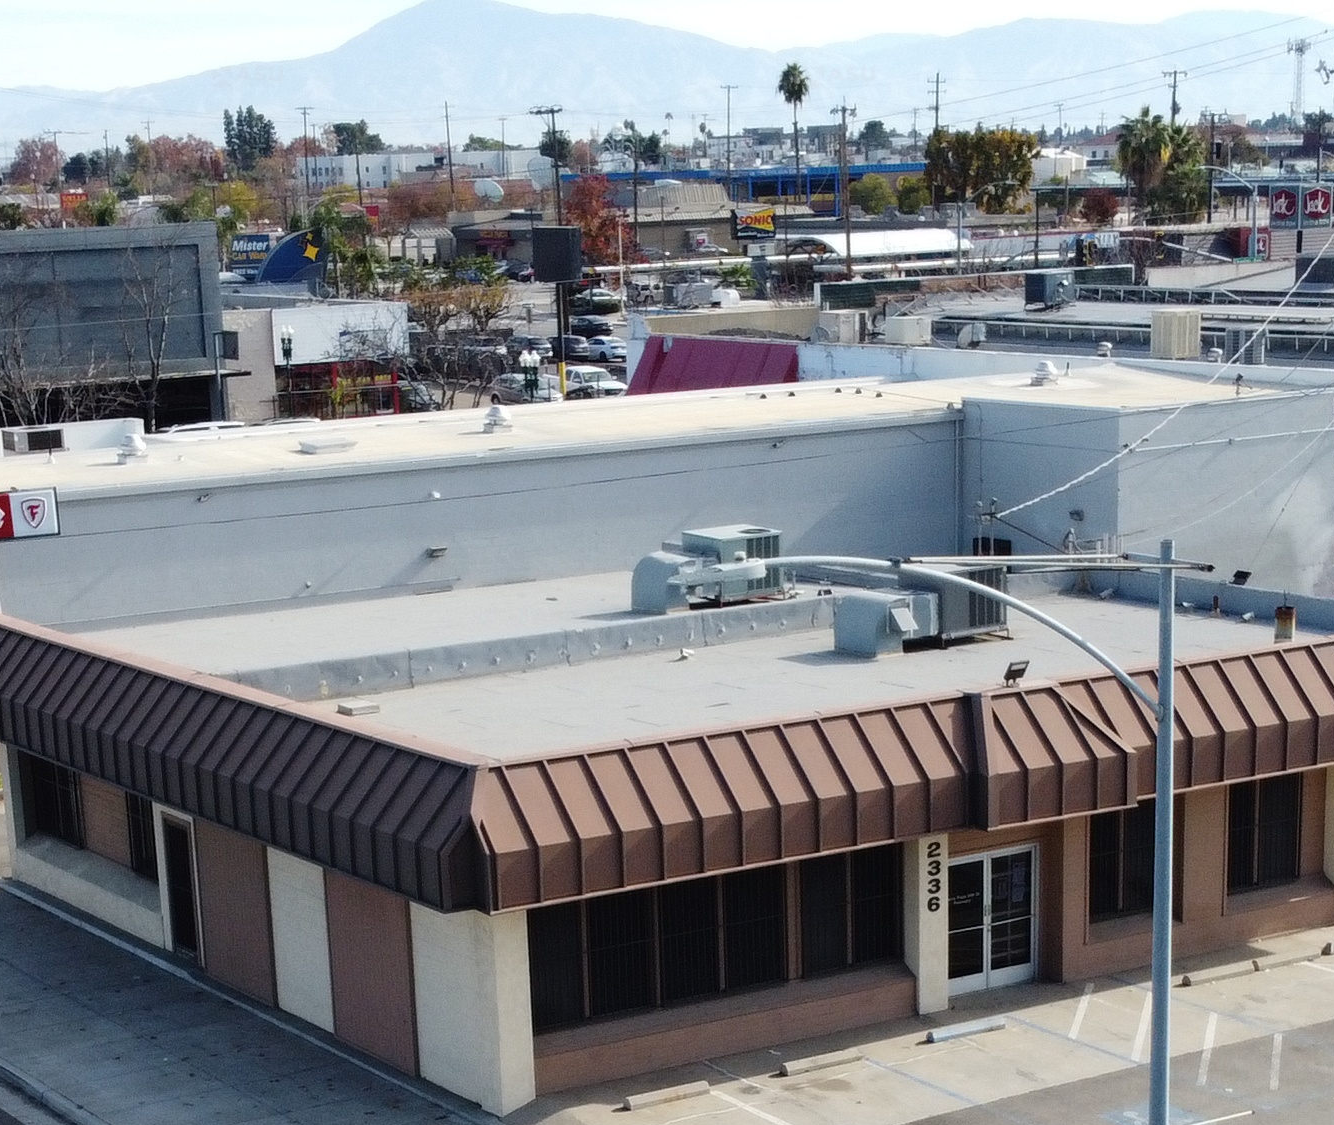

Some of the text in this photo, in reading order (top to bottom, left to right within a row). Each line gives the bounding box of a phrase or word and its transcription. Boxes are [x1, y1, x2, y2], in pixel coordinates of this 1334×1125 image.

[1304, 191, 1330, 214] Jack
[739, 215, 772, 225] SONIC
[232, 240, 268, 251] Mister
